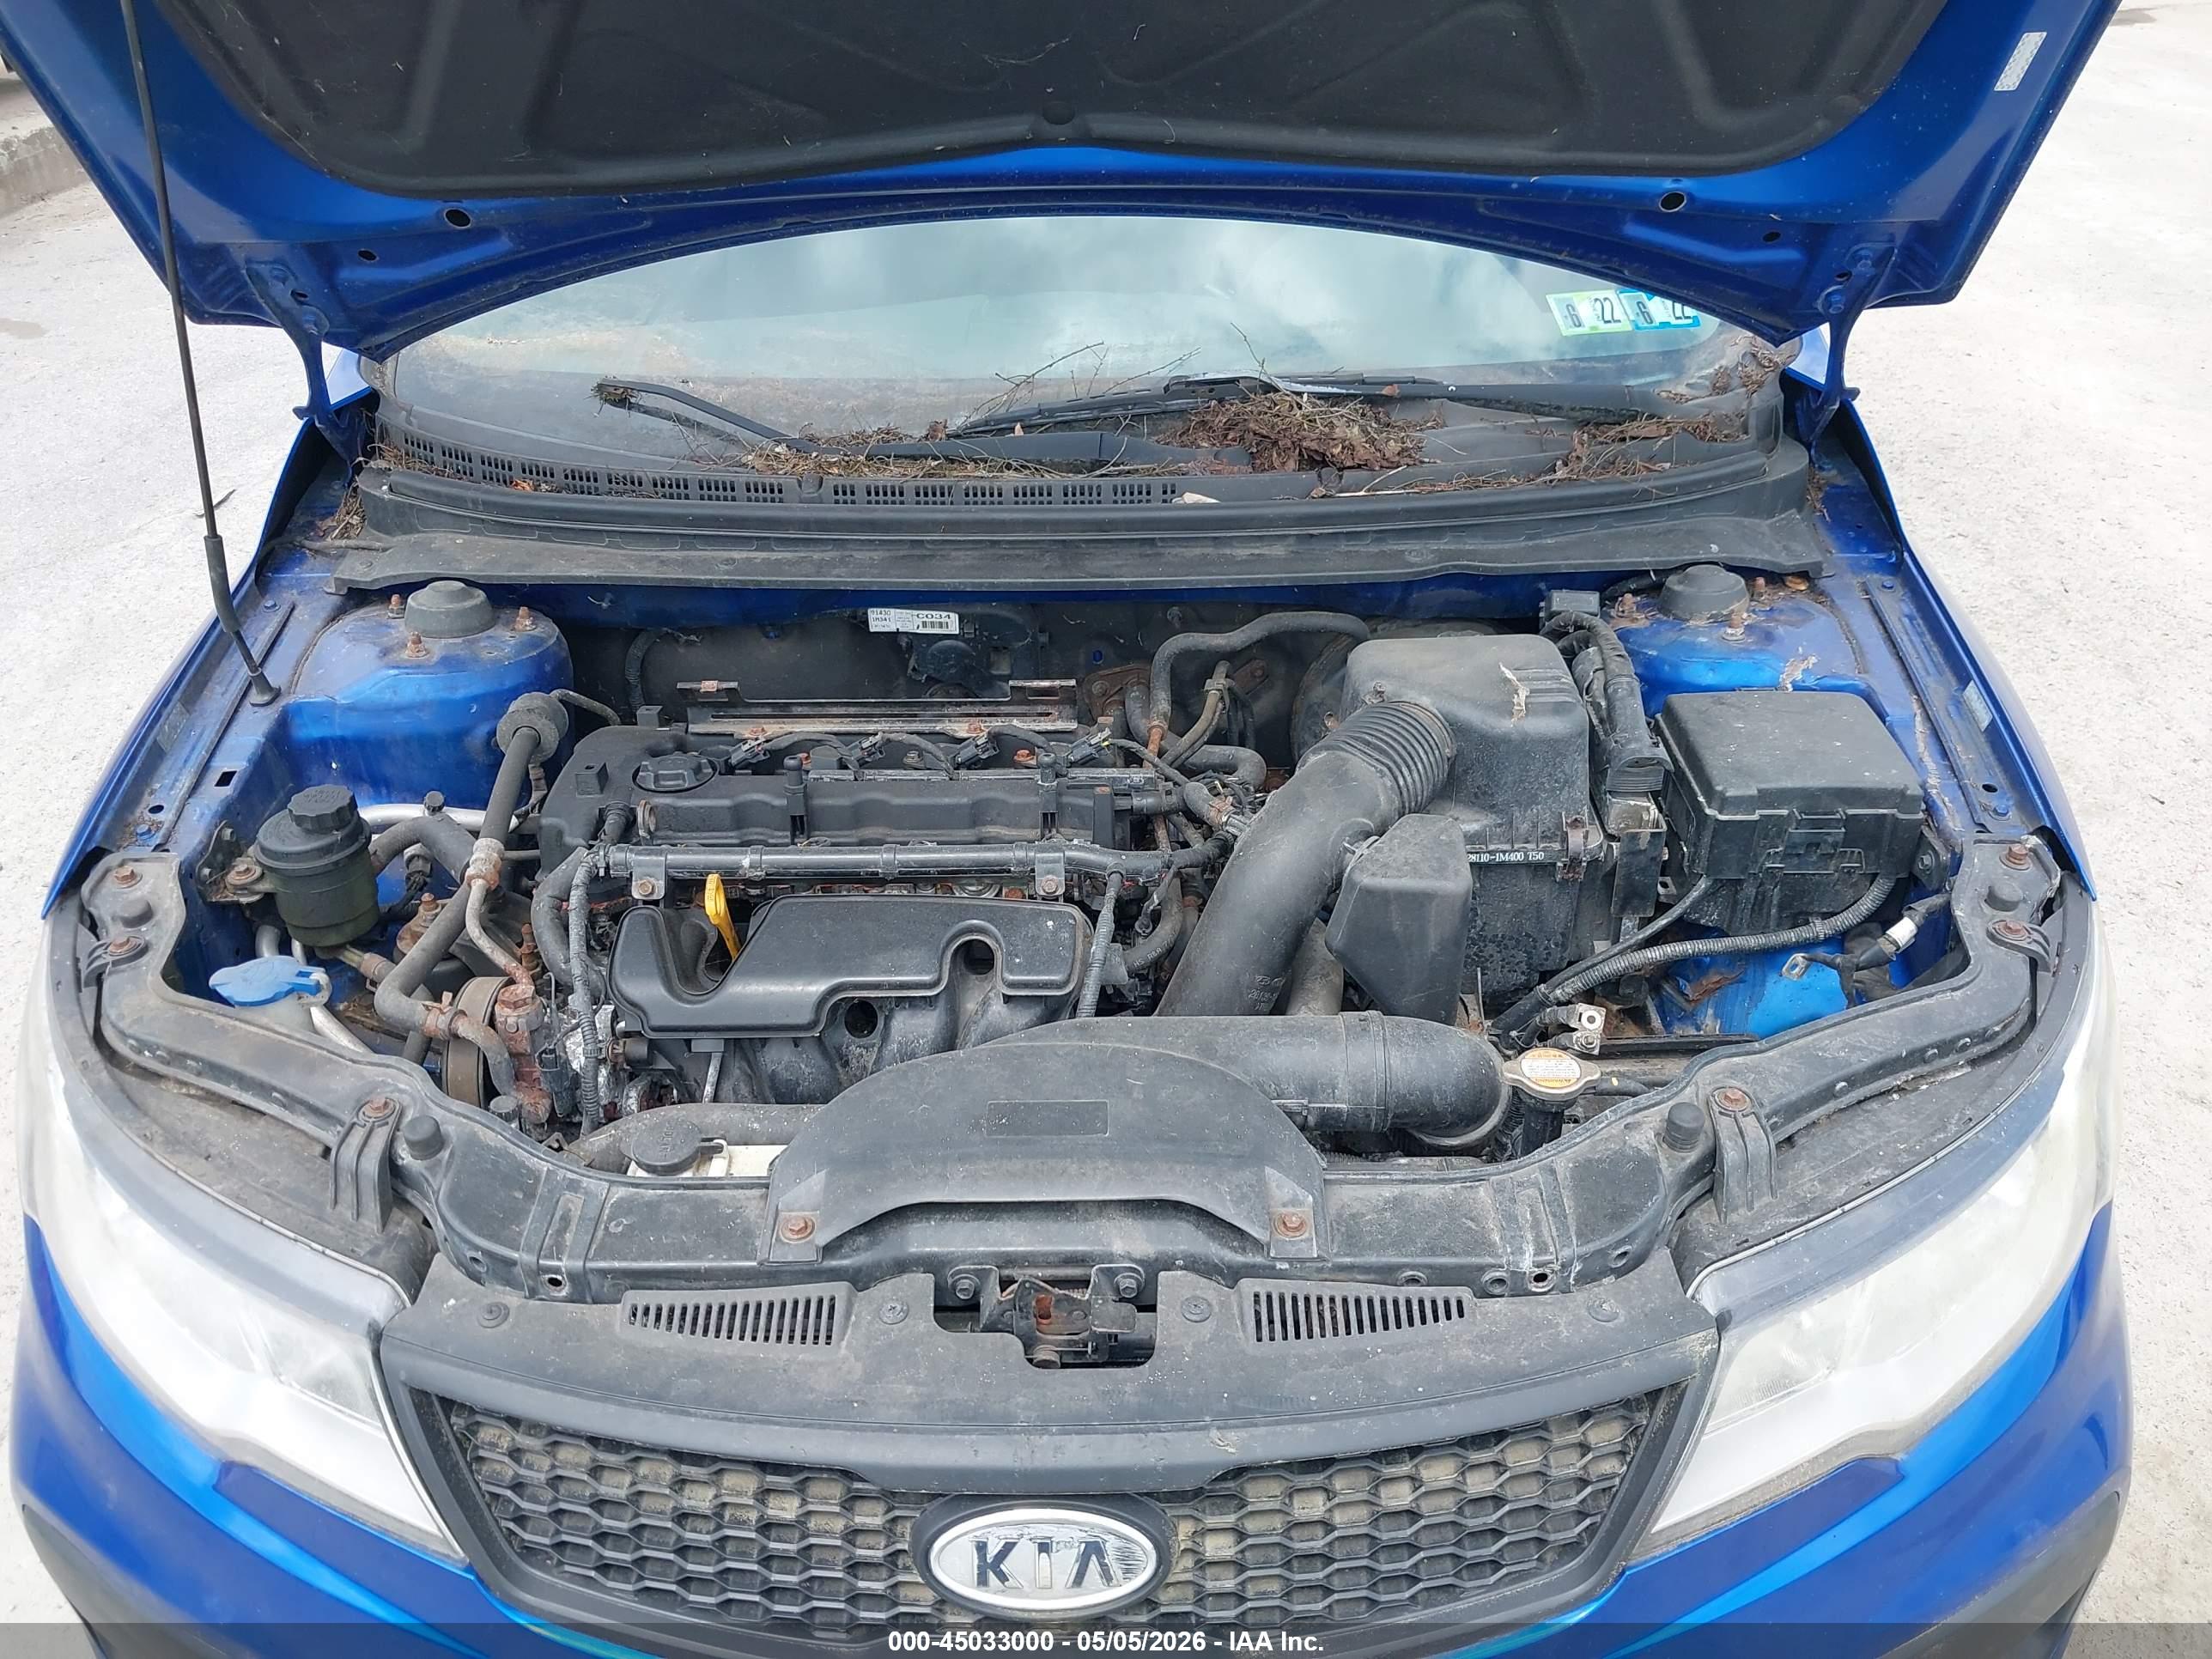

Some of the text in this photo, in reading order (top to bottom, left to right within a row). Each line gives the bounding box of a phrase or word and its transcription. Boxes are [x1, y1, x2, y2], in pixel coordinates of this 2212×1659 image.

[1565, 303, 1582, 328] 6
[1593, 297, 1622, 324] 22
[1636, 301, 1654, 325] 6
[1467, 851, 1524, 863] 28110-1M400
[969, 1537, 1121, 1589] KIA
